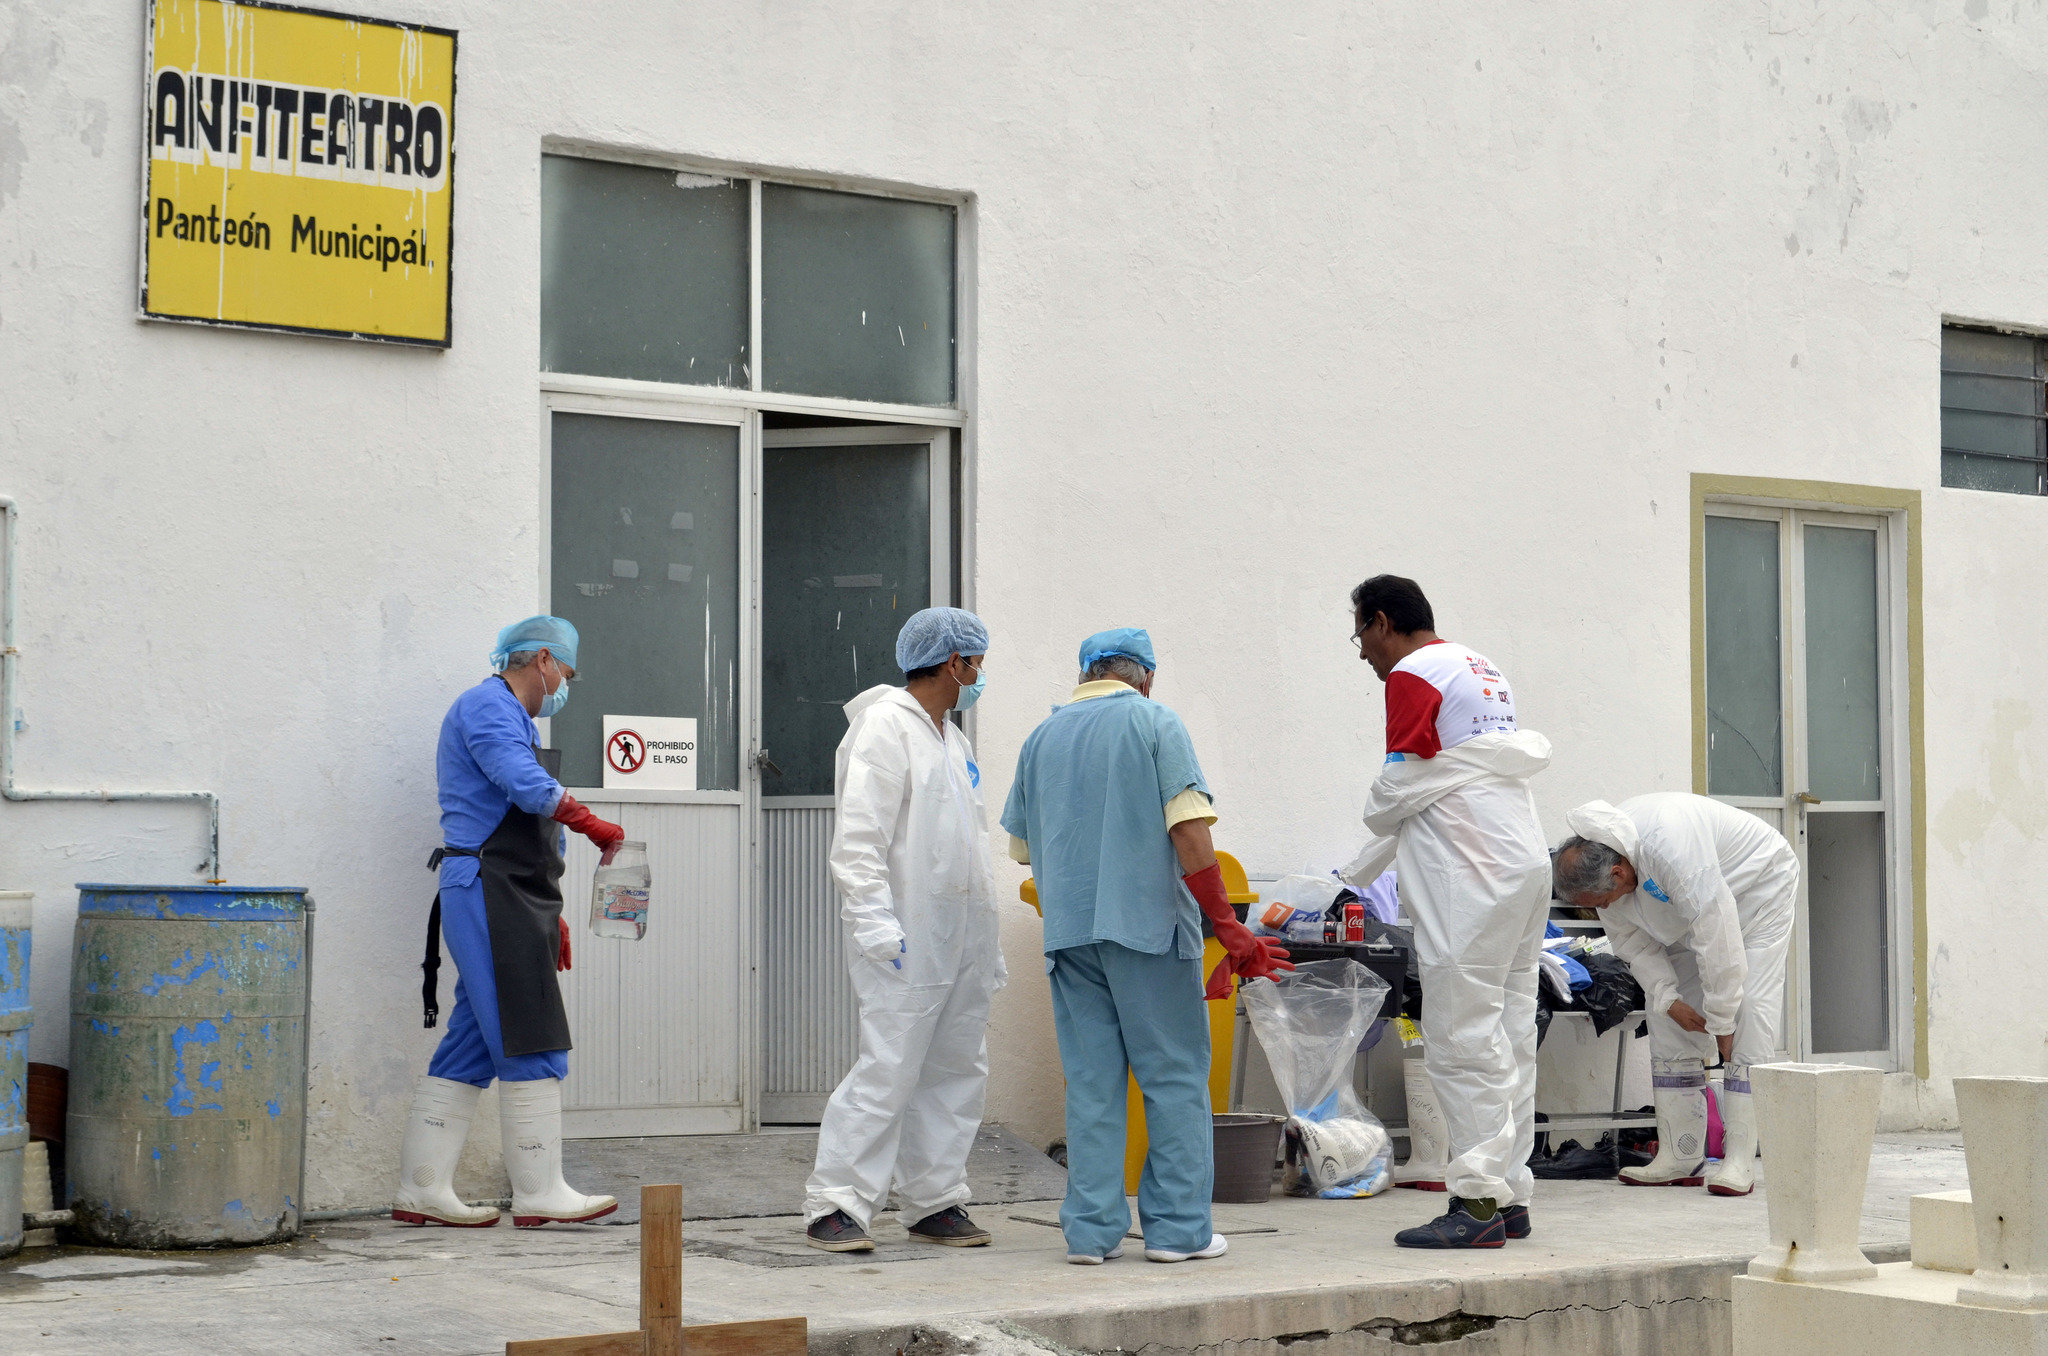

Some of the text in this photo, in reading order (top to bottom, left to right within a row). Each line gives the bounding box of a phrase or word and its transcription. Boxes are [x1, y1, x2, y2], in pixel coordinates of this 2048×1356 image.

[154, 68, 445, 186] ANFITEATRO
[156, 197, 271, 251] Panteón
[646, 741, 695, 751] PROHIBIDO
[653, 755, 688, 764] EL PASO
